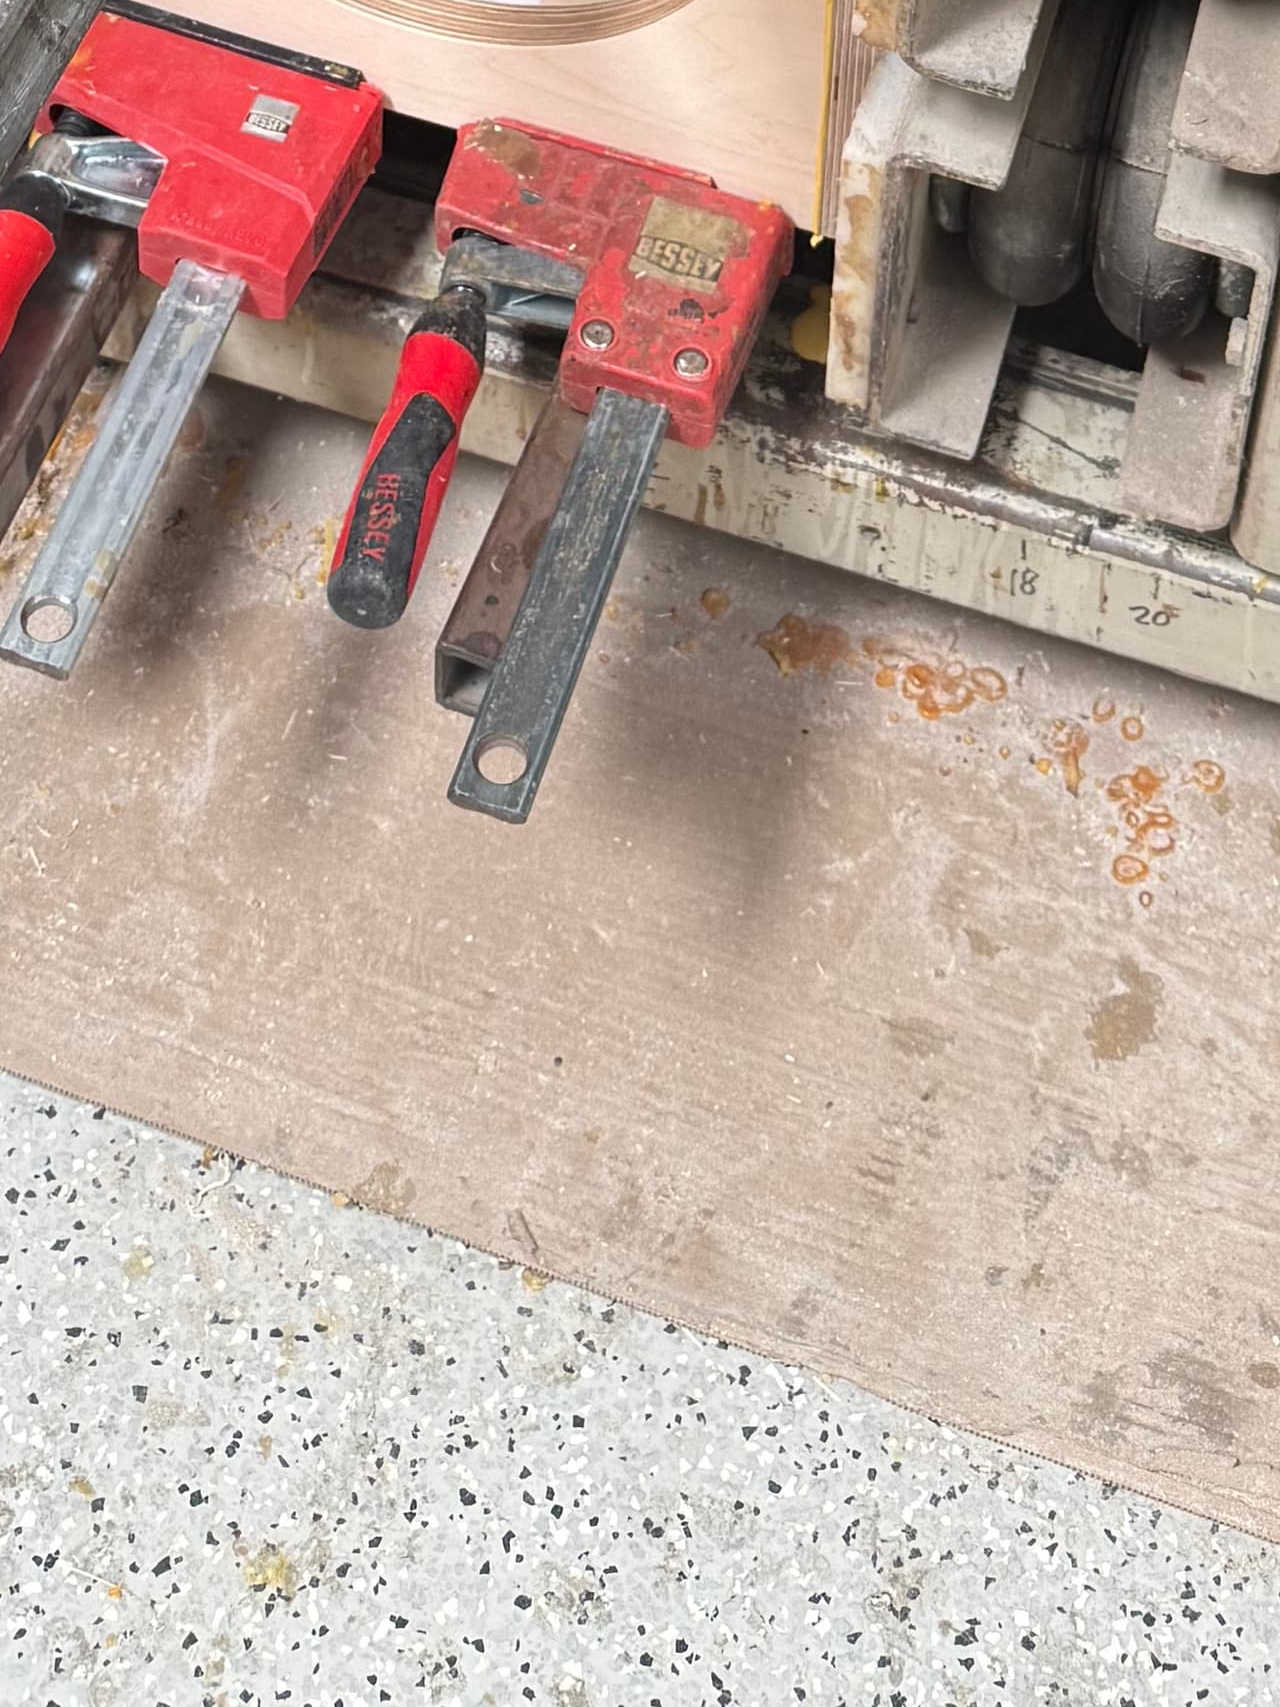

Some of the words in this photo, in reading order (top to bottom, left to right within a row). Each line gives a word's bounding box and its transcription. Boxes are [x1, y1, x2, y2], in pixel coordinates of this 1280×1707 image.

[633, 235, 723, 281] BESSEY
[360, 472, 401, 564] BESSEY
[1010, 566, 1041, 597] 18
[1128, 605, 1172, 627] 20
